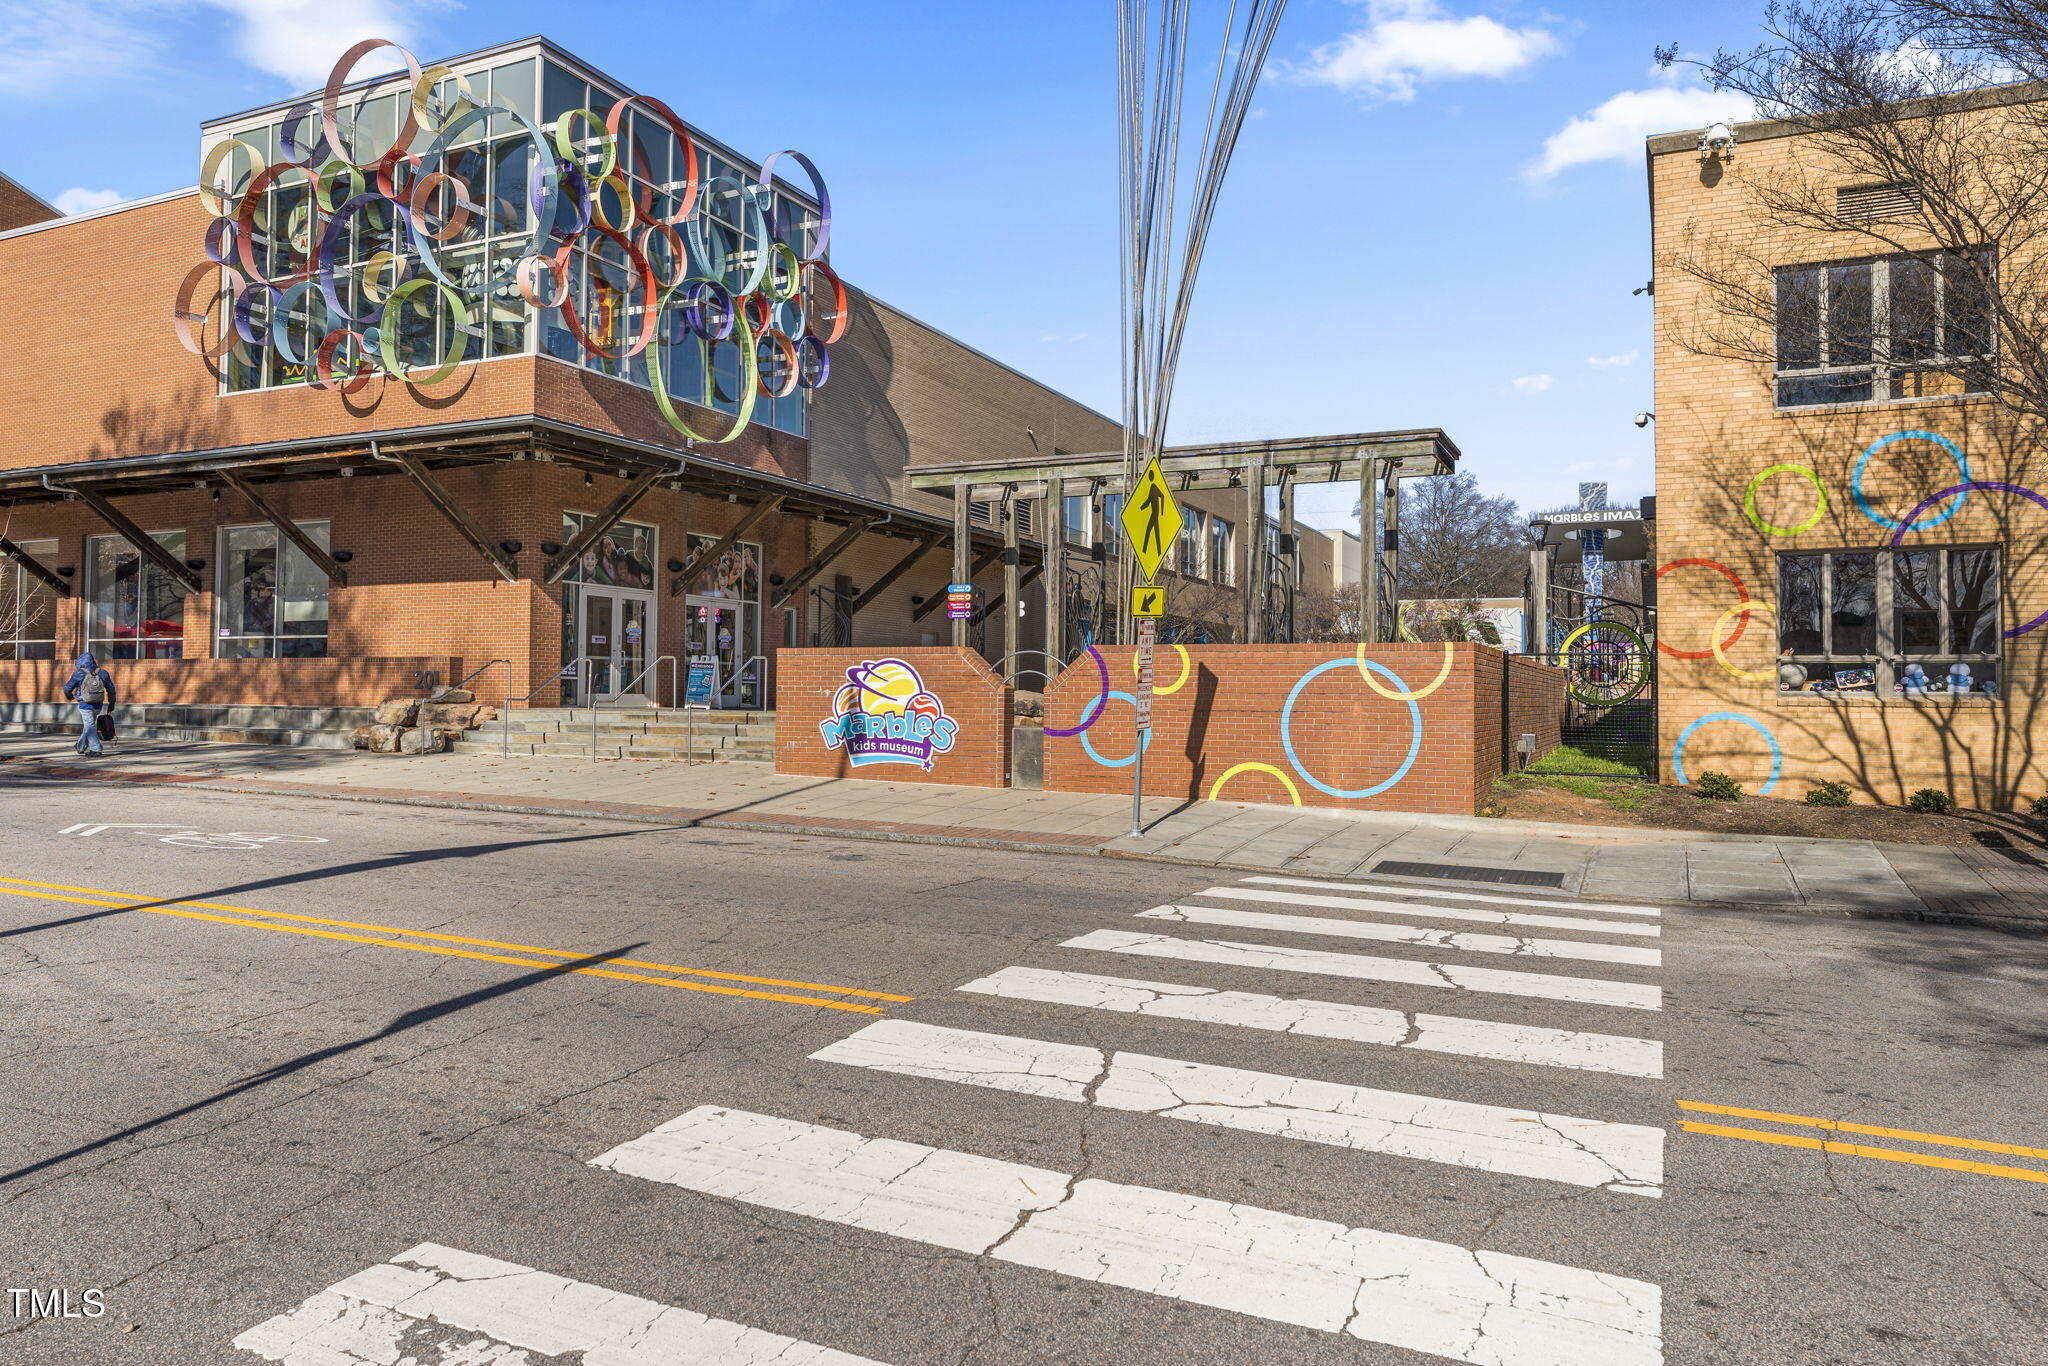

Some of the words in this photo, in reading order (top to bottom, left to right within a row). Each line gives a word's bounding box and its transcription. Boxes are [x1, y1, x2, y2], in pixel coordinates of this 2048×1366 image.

[1544, 512, 1600, 523] MaRBLeS
[413, 670, 440, 689] 201
[821, 709, 957, 750] MaRbLeS
[853, 741, 876, 751] kids
[880, 741, 924, 757] museum
